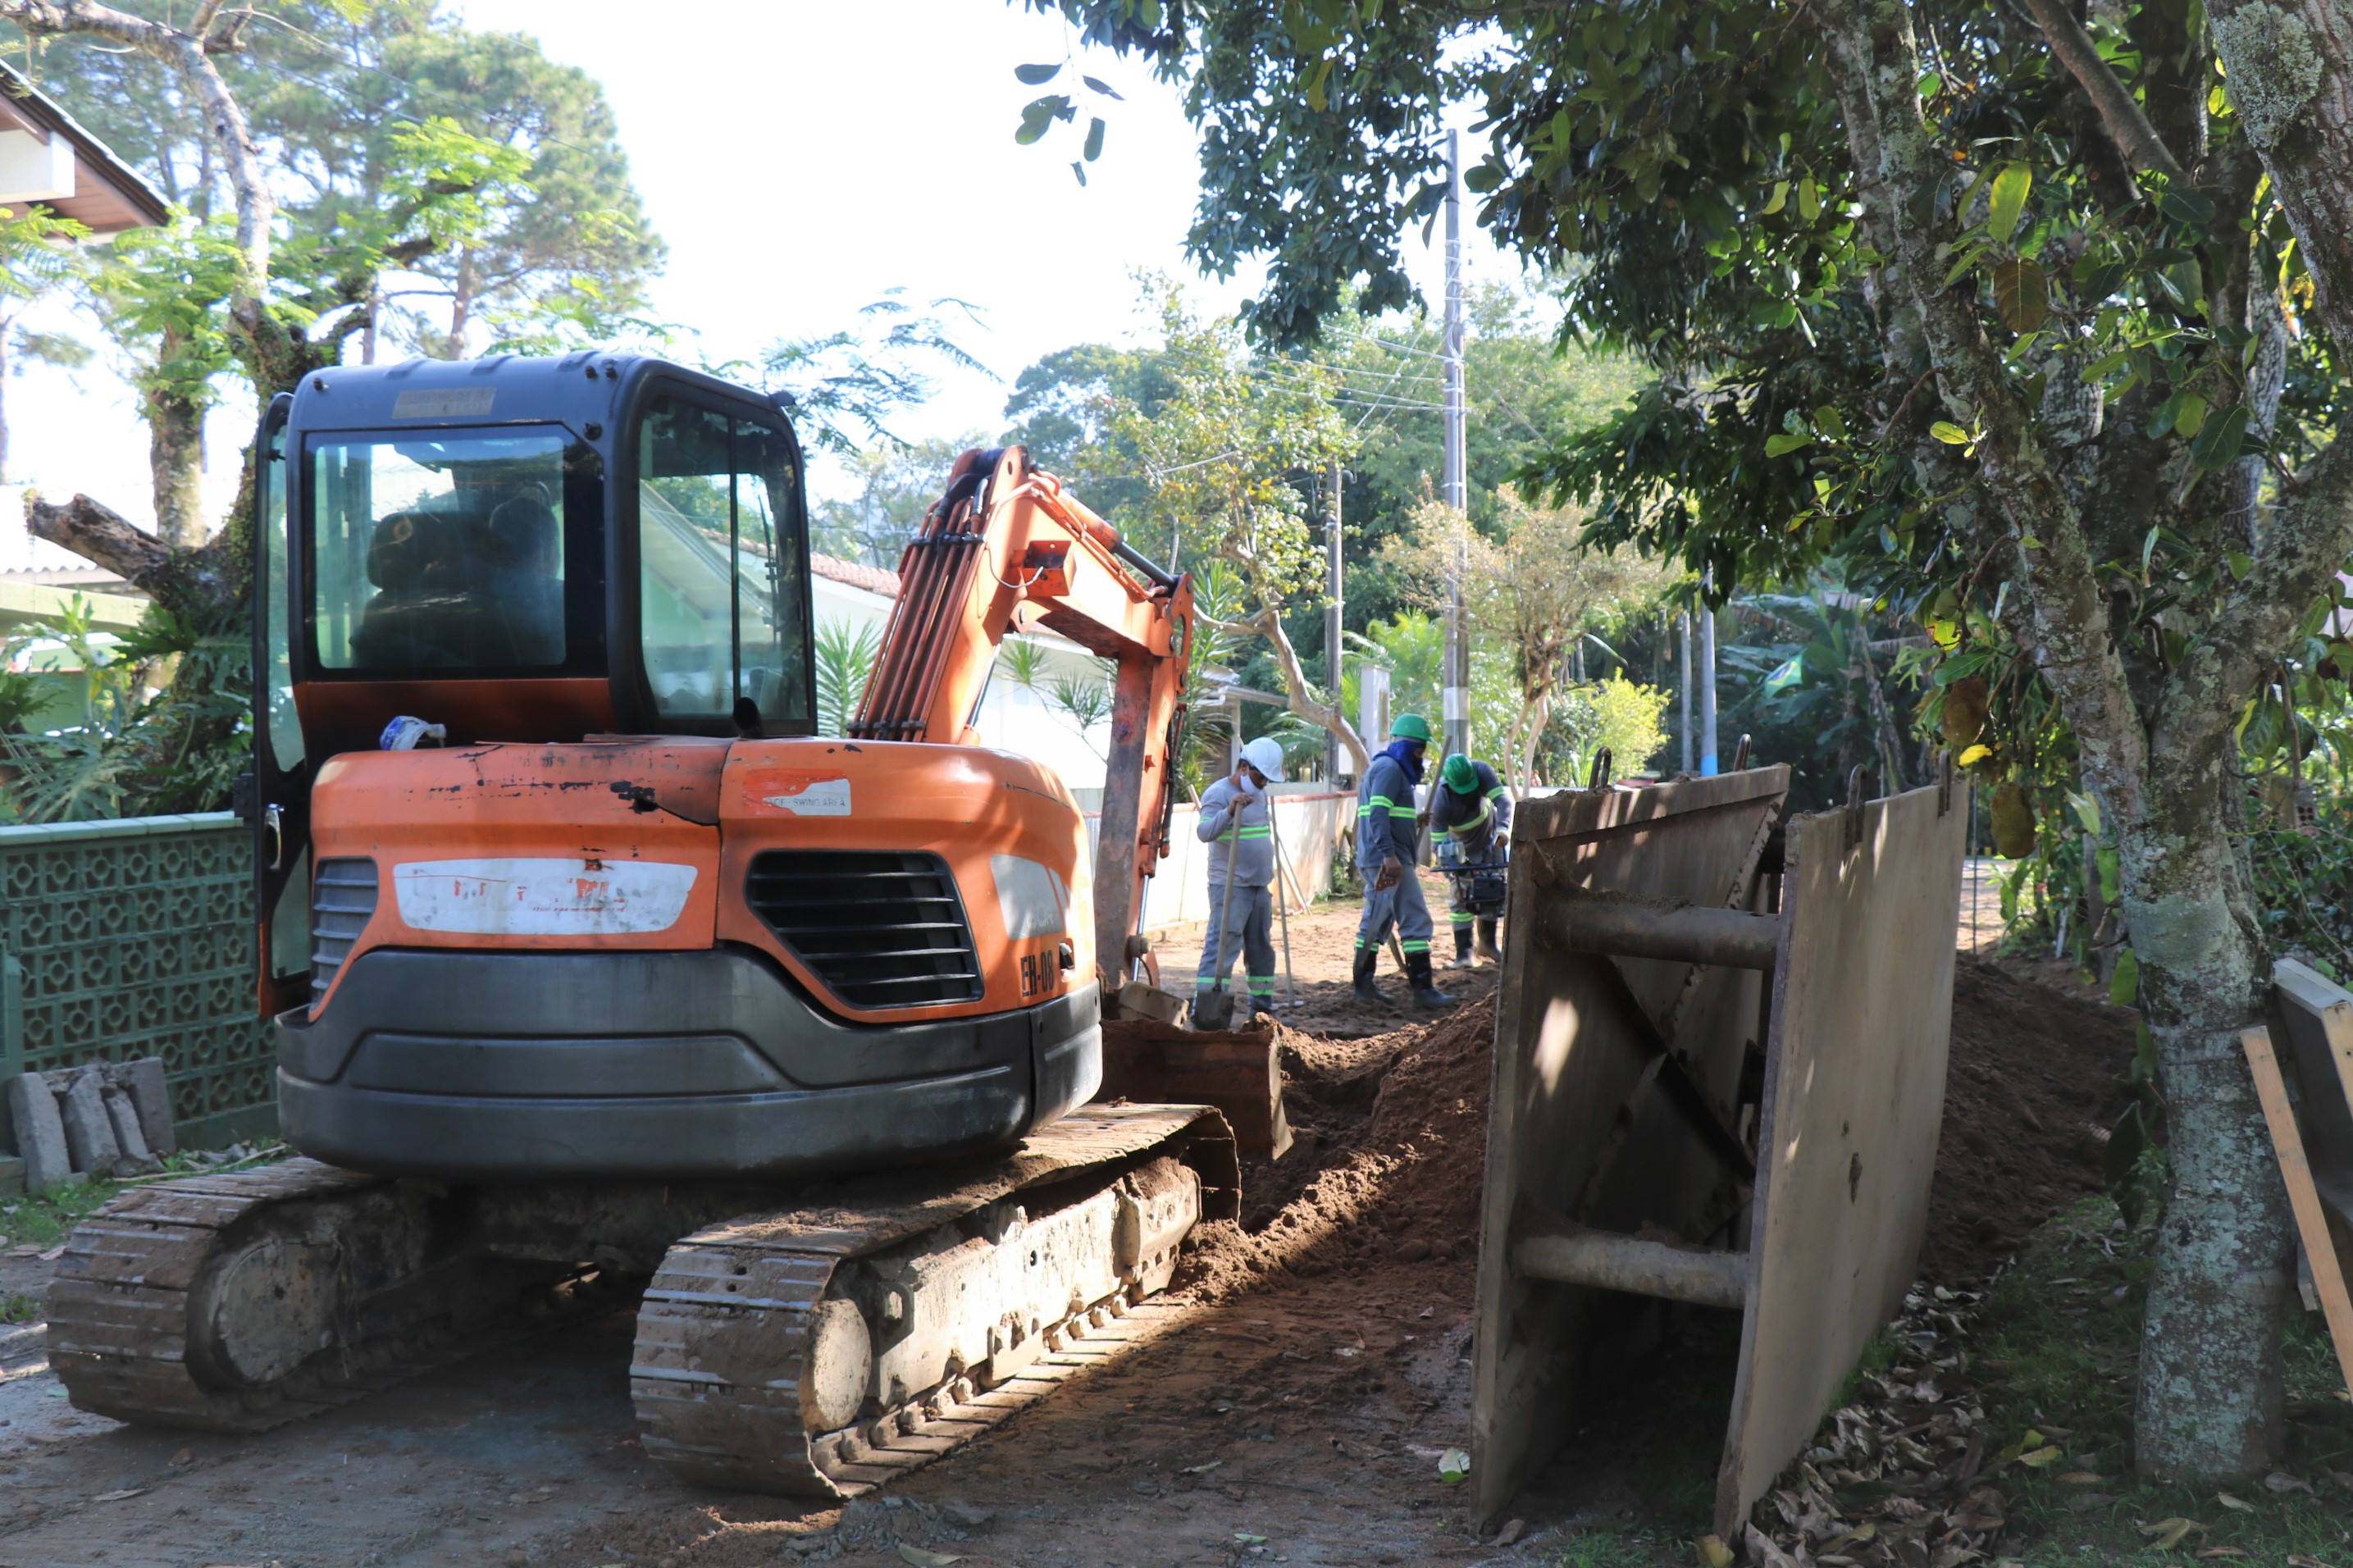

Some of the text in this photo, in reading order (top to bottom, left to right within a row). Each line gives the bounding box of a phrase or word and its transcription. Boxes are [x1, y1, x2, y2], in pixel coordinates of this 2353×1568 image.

[792, 797, 821, 807] SWING
[823, 797, 846, 807] AREA
[1020, 950, 1054, 997] EH-08
